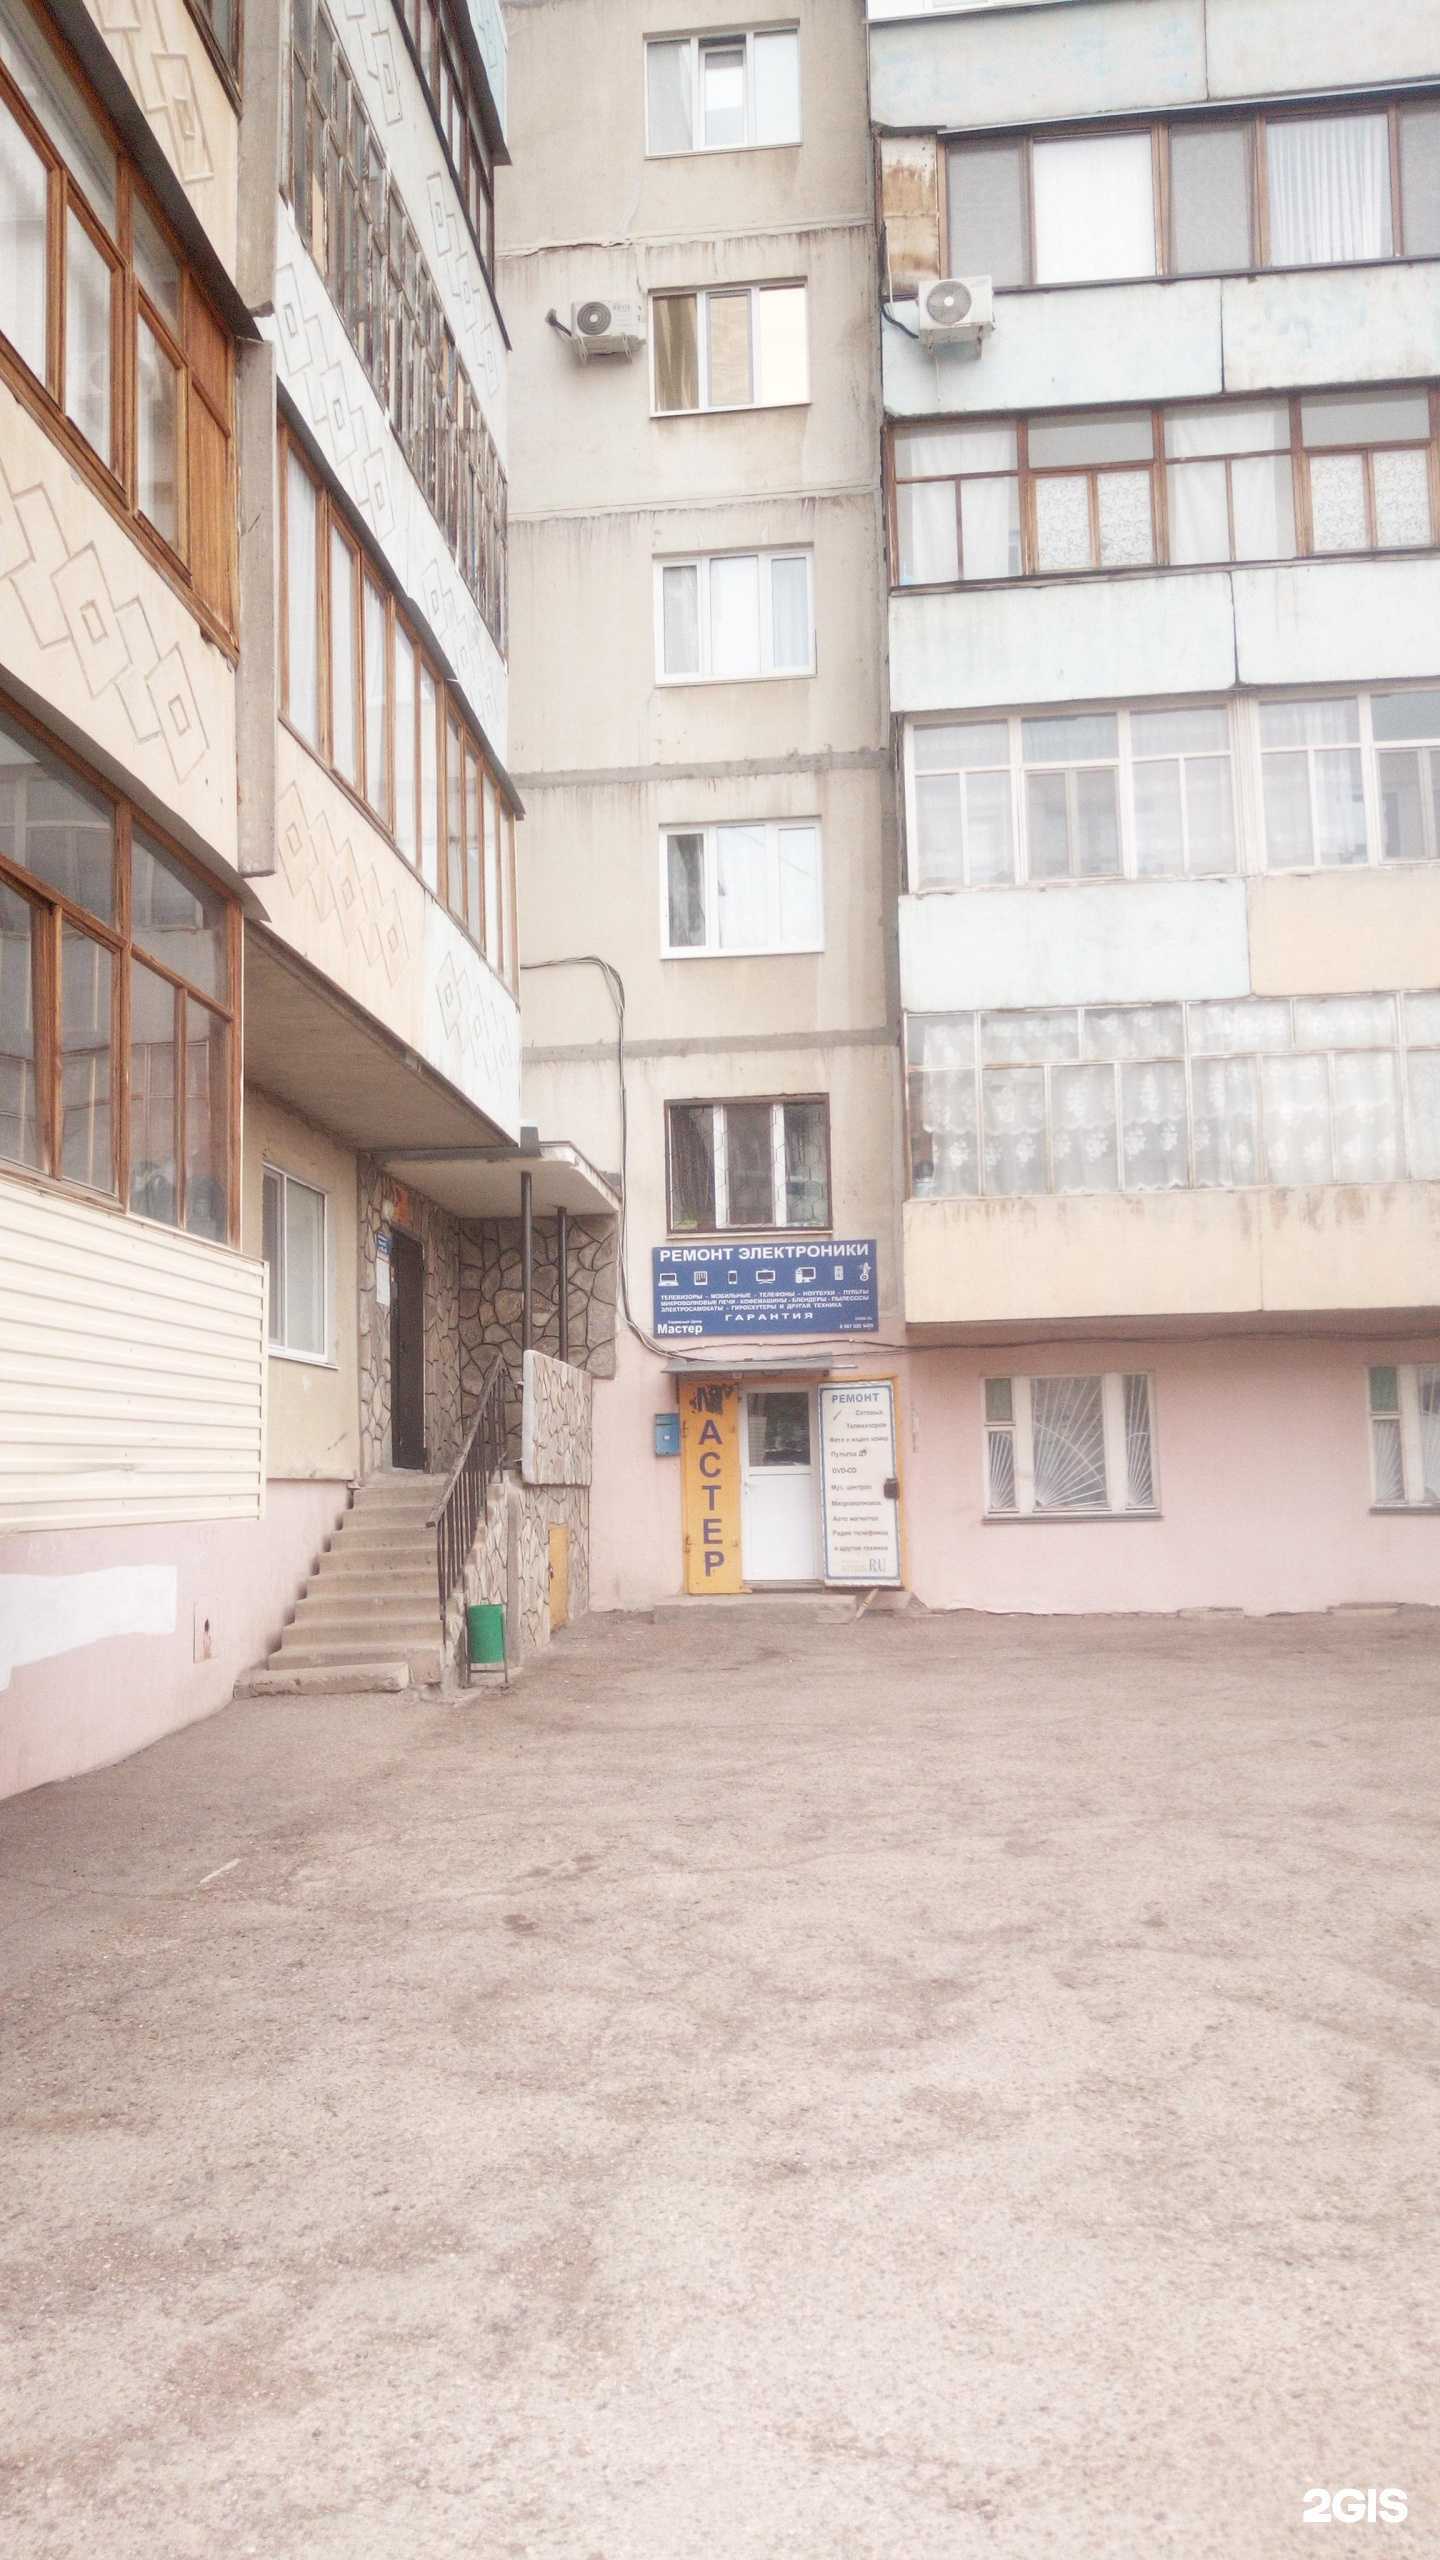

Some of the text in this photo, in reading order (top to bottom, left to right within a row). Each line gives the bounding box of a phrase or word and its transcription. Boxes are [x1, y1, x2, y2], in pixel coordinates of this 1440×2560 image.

[660, 1244, 869, 1262] РЕМОНТ ЭЛЕКТРОНИКИ
[661, 1305, 723, 1313] ЭЛЕКТРОСАМОКАТЫ
[725, 1312, 813, 1322] ГАРАНТИЯ
[657, 1324, 703, 1335] Мастер
[831, 1392, 880, 1404] РЕМОНТ
